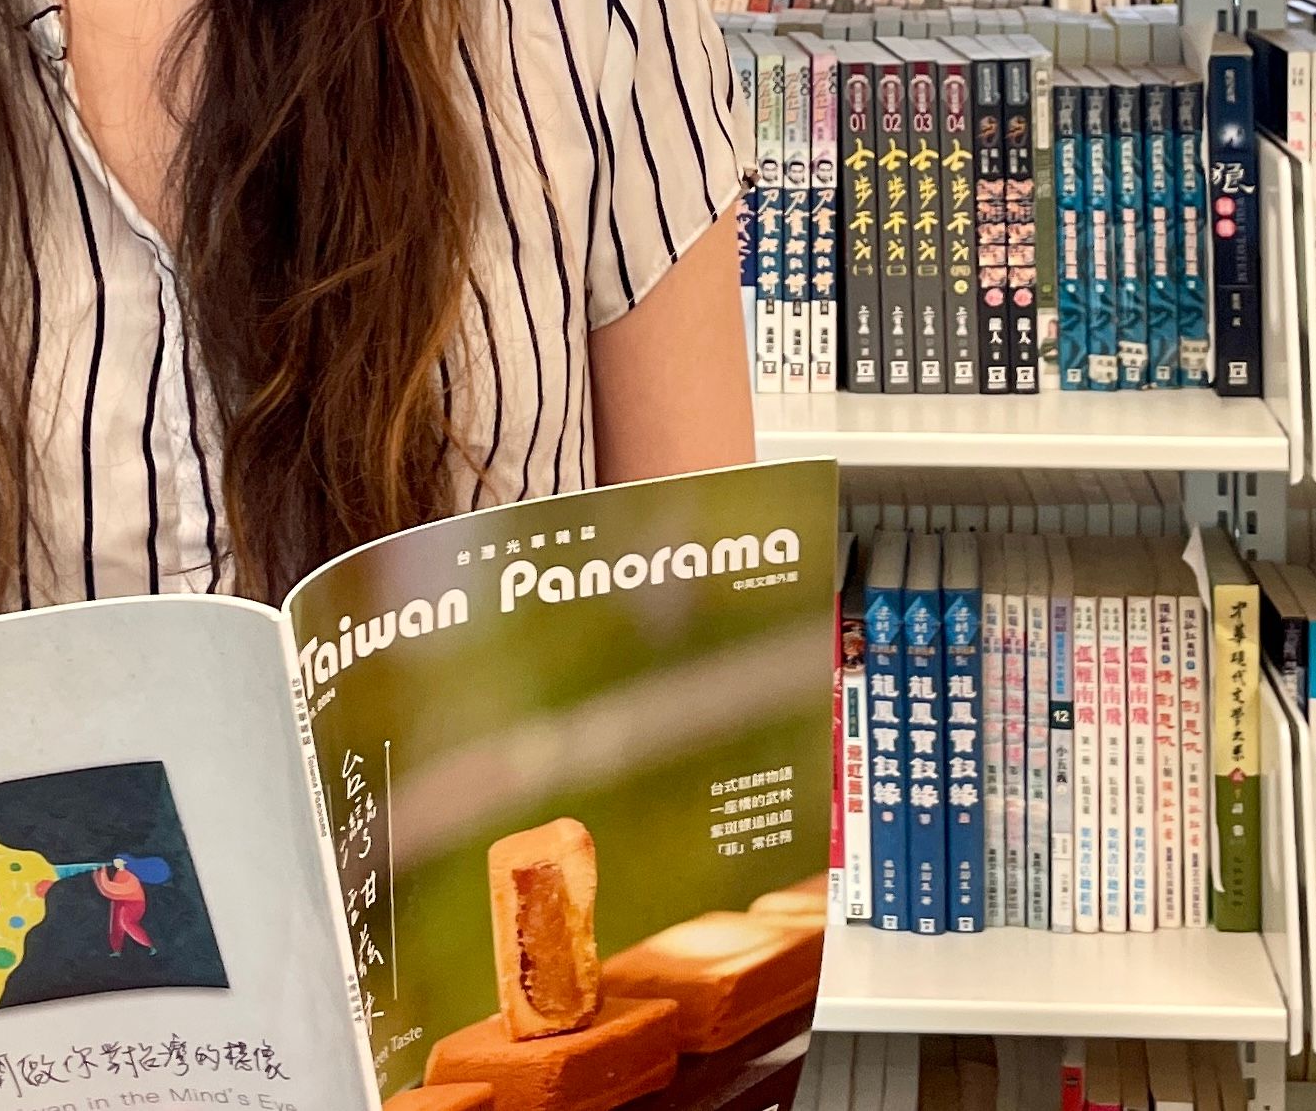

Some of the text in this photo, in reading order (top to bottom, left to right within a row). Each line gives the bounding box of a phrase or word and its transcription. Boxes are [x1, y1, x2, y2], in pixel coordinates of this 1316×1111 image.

[850, 114, 866, 132] 01
[883, 114, 901, 132] 02
[914, 114, 932, 132] 03
[946, 114, 965, 132] 04
[299, 528, 800, 698] Taiwan Panorama
[1053, 710, 1069, 723] 12
[389, 1027, 423, 1053] Taste
[87, 1095, 109, 1109] in
[123, 1089, 160, 1105] the
[169, 1086, 250, 1107] Mind's
